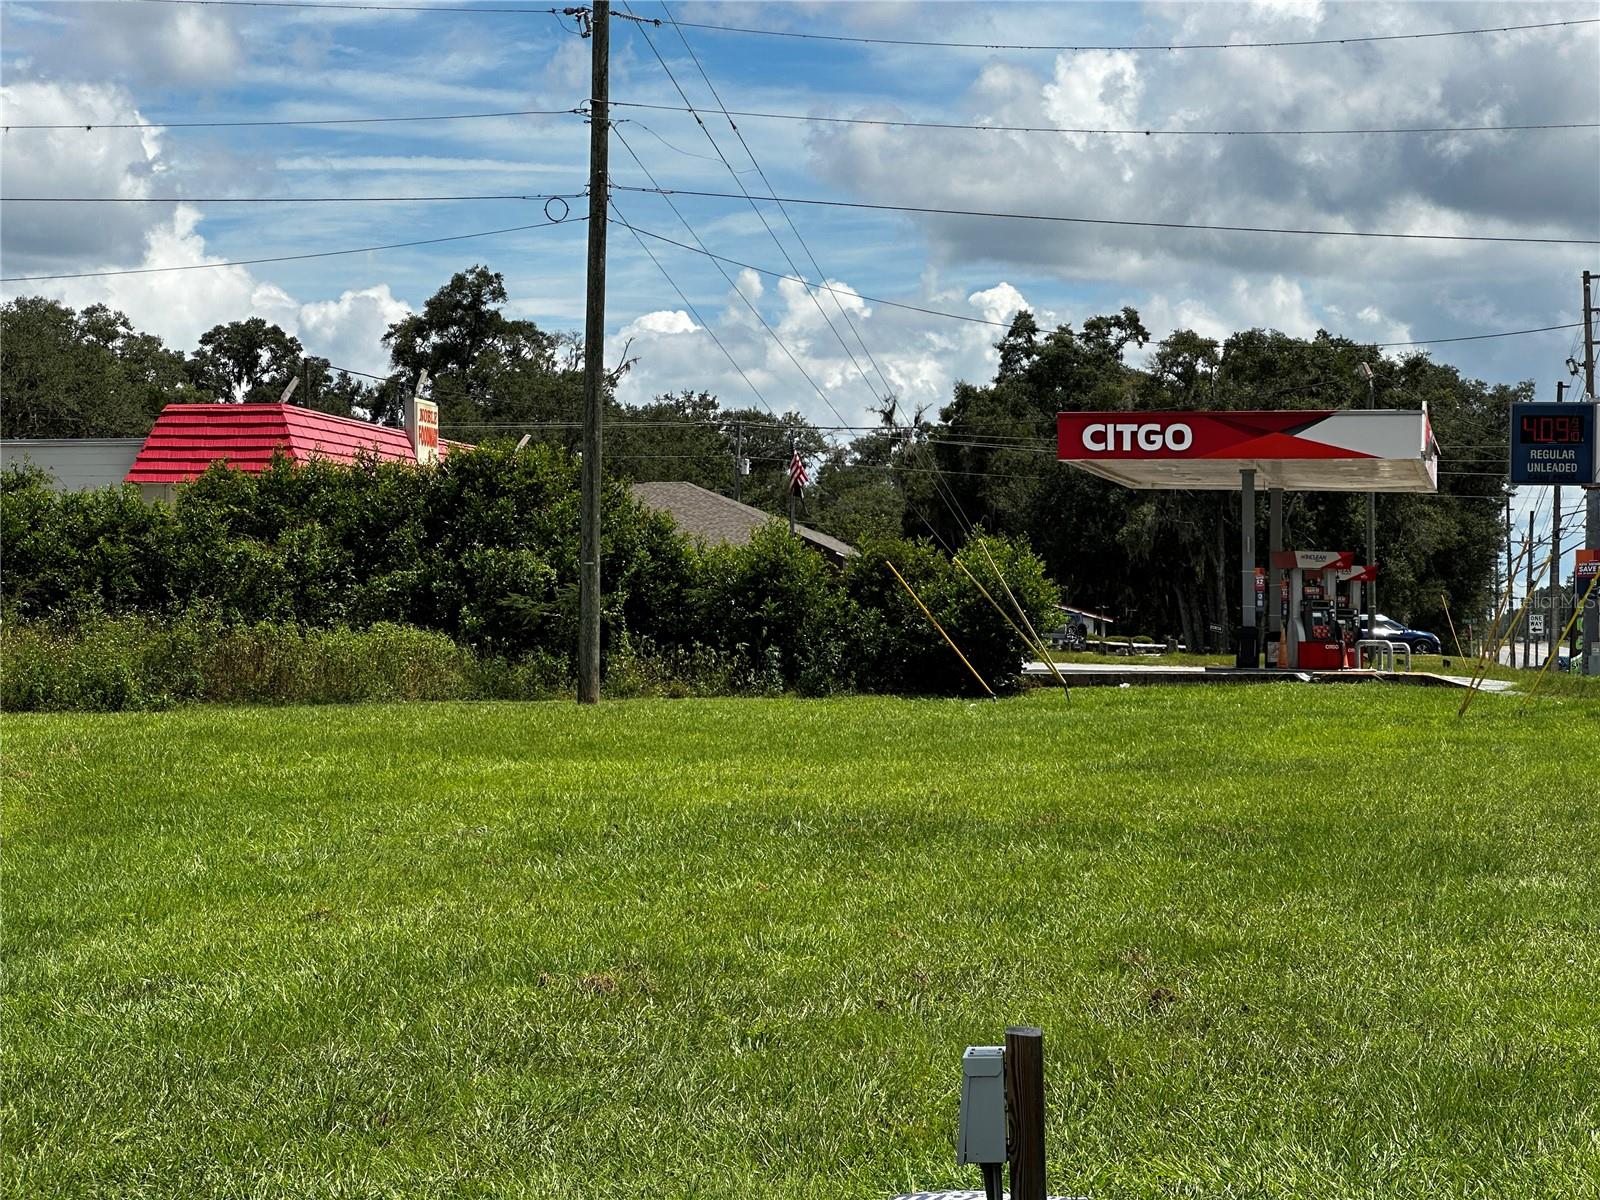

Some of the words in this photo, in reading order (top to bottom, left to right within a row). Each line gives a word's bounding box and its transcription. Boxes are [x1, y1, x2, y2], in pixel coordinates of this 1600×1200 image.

[419, 408, 437, 424] NOBLE
[1081, 423, 1193, 451] CITGO
[1530, 449, 1575, 459] REGULAR
[1527, 463, 1578, 472] UNLEADED
